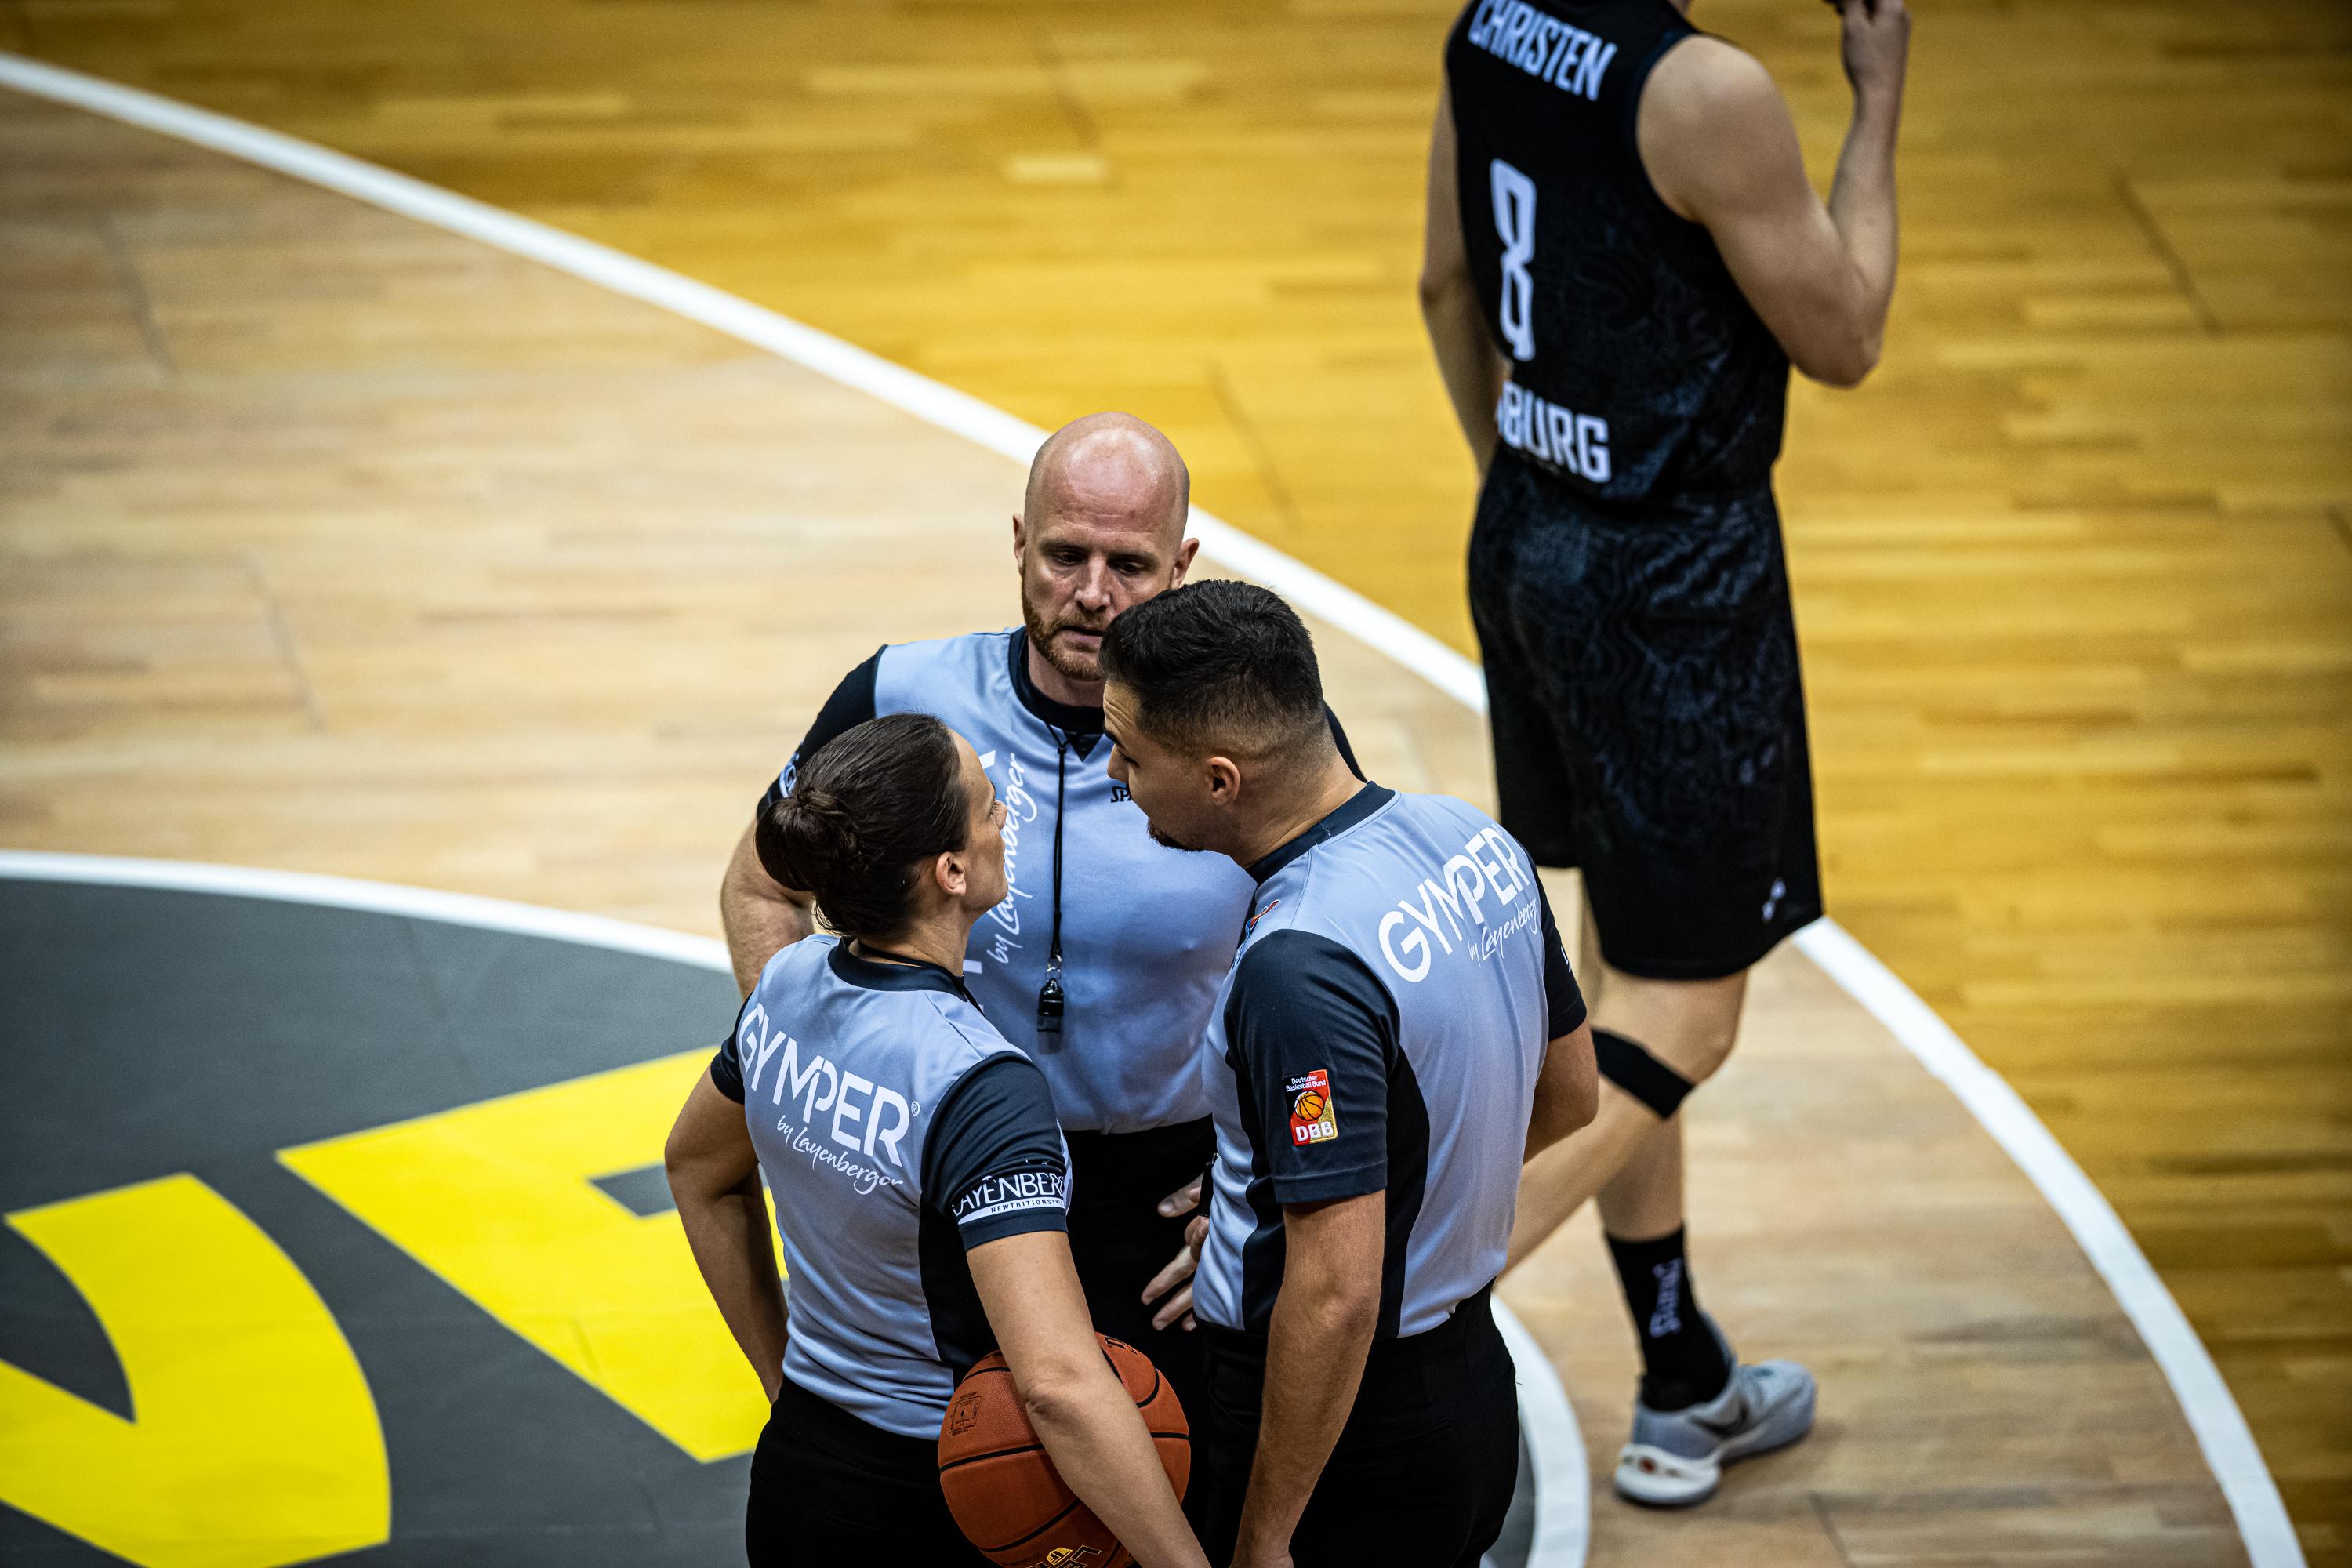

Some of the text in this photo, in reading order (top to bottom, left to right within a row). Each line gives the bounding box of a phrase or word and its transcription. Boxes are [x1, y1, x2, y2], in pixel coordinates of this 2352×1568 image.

[1468, 0, 1618, 101] CHRISTEN
[1490, 158, 1537, 361] 8
[1496, 379, 1611, 483] BURG
[987, 933, 1022, 964] by
[1468, 940, 1482, 968] by
[1286, 1079, 1327, 1092] Basketball Bund
[1291, 1075, 1318, 1085] Deutscher
[777, 1115, 794, 1147] by
[1295, 1121, 1334, 1142] DBB
